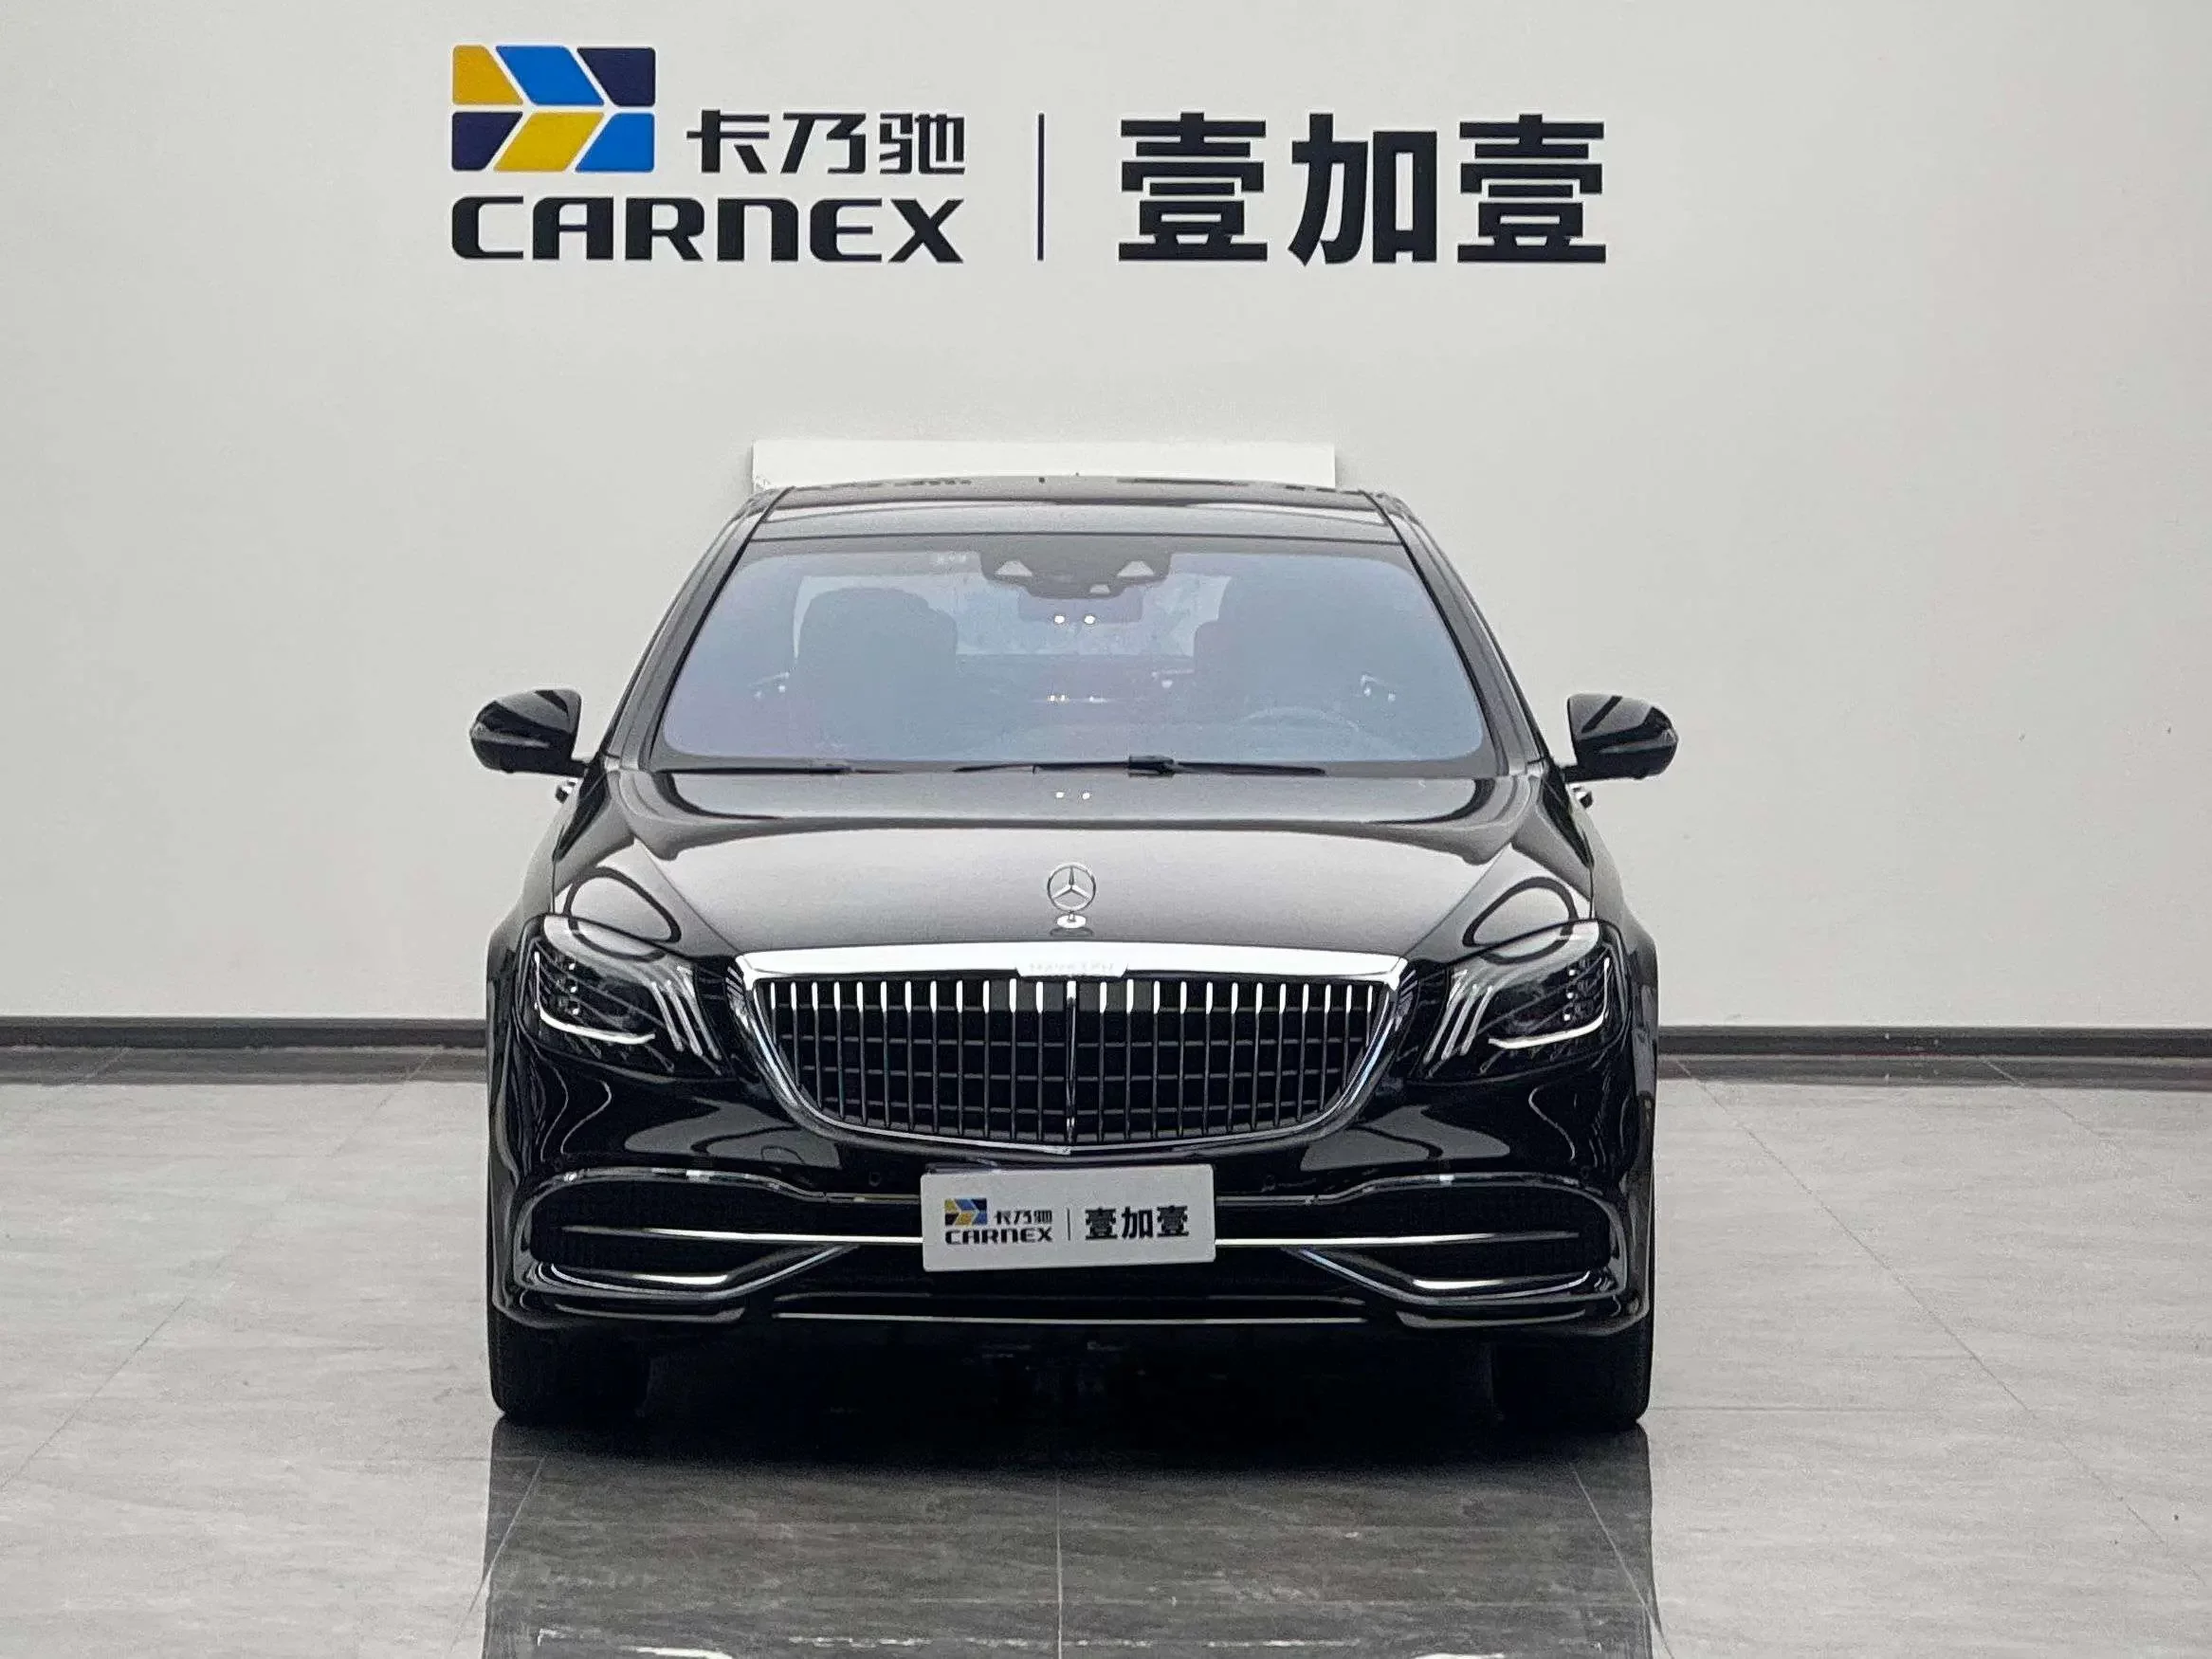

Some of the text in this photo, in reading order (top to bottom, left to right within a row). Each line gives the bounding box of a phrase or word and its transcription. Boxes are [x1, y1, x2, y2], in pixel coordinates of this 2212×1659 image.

[686, 109, 965, 175] 卡乃驰
[1118, 112, 1607, 266] 壹加壹
[451, 195, 964, 264] CARNEX
[944, 1226, 1053, 1246] CARNEX
[1085, 1204, 1190, 1241] 壹加壹
